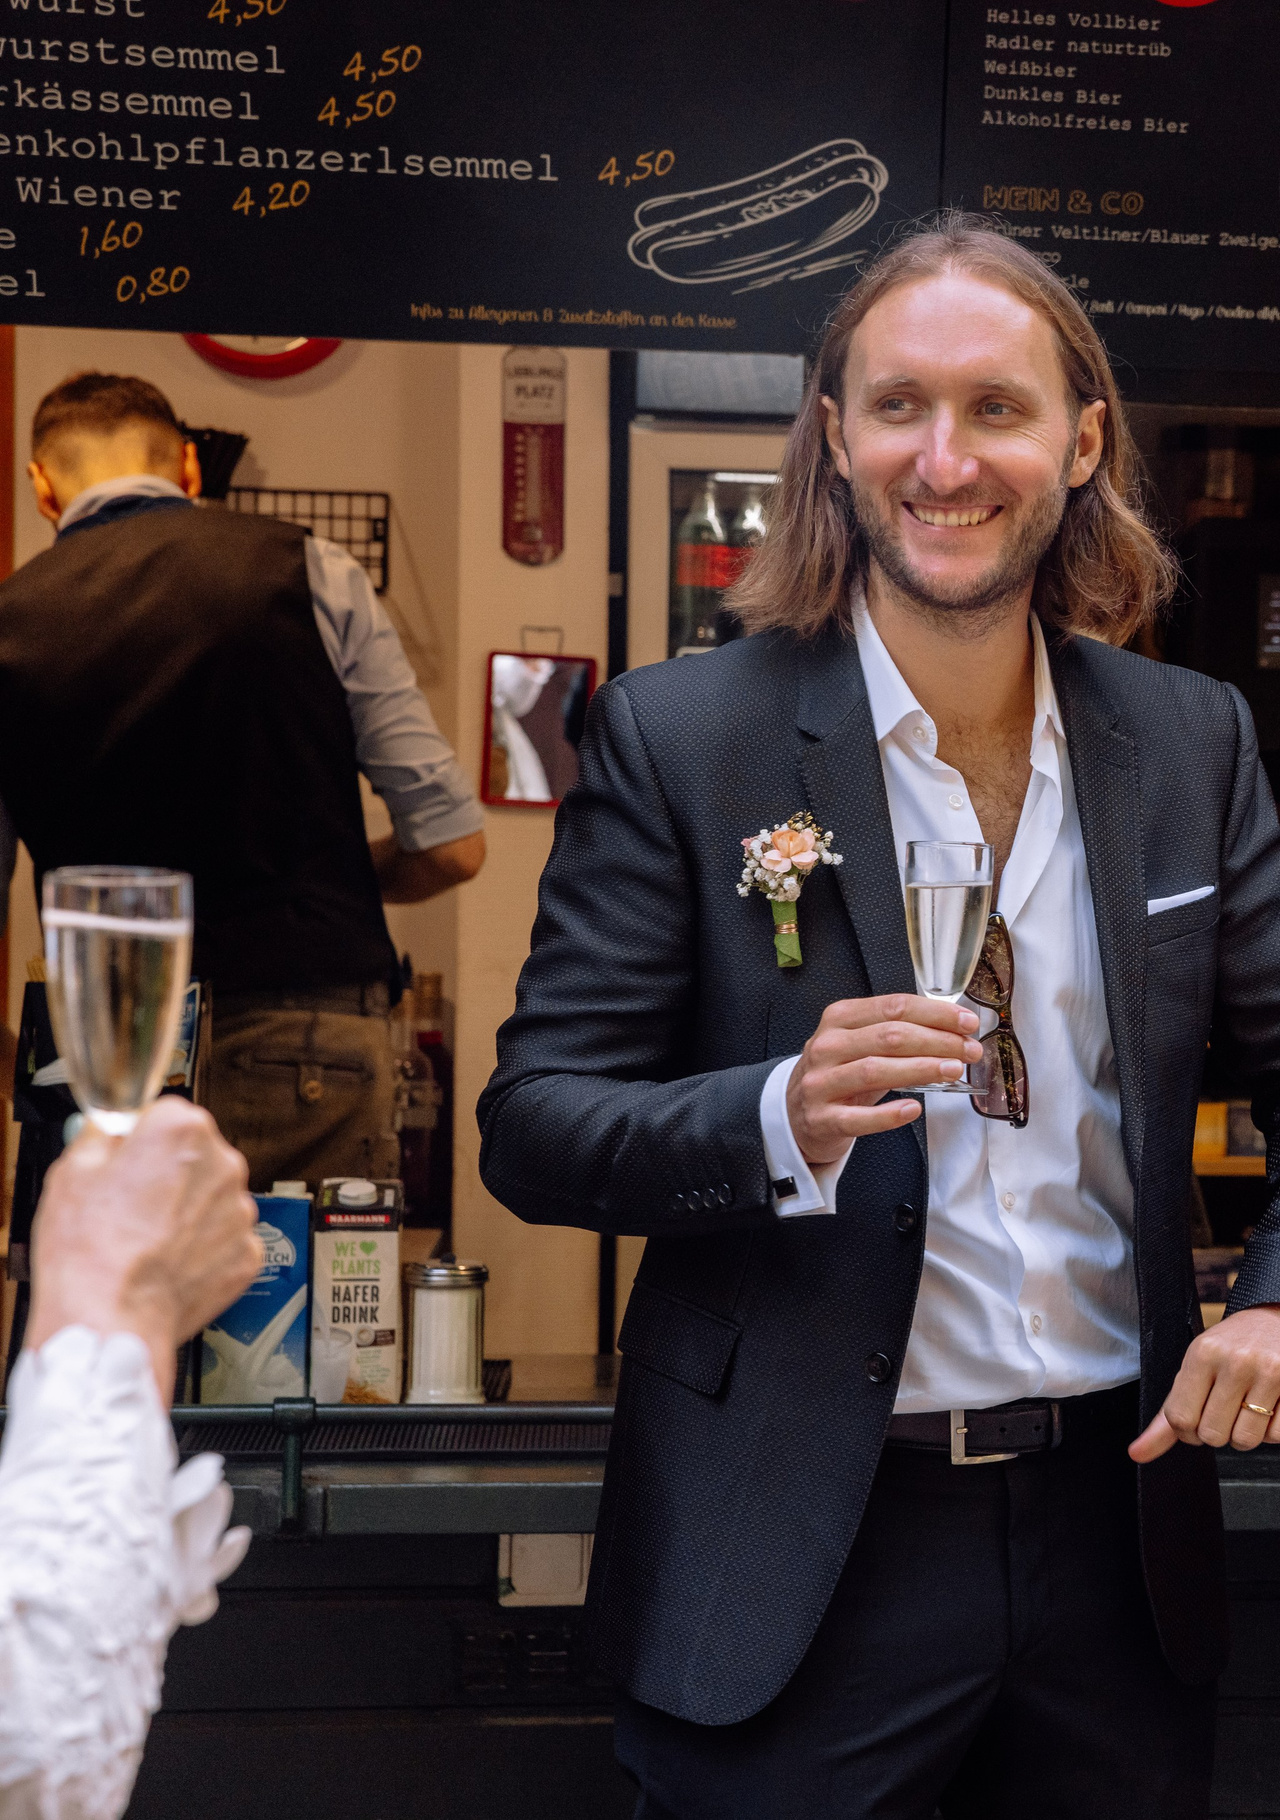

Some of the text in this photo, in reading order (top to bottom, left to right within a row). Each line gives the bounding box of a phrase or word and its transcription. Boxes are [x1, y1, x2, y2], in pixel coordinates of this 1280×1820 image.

[986, 9, 1056, 26] Helles
[1068, 12, 1161, 31] Vollbier
[985, 35, 1055, 52] Radler
[1067, 40, 1172, 58] naturtrüb
[343, 45, 422, 82] 4,50
[984, 59, 1077, 78] Weißbier
[983, 85, 1064, 104] Dunkles
[1076, 89, 1122, 105] Bier
[317, 90, 397, 128] 4,50
[982, 110, 1132, 132] Alkoholfreies
[1143, 117, 1189, 134] Bier
[598, 150, 675, 187] 4,50
[17, 177, 310, 217] Wiener 4,20
[983, 185, 1145, 216] WEIN & CO
[80, 220, 143, 259] 1,60
[1051, 225, 1209, 247] Veltliner/Blauer
[116, 267, 190, 303] 0,80
[448, 307, 464, 319] zu
[649, 313, 669, 327] an
[335, 1242, 356, 1256] WE
[332, 1260, 380, 1276] PLANTS
[332, 1286, 379, 1302] HAFER
[332, 1306, 379, 1323] DRINK
